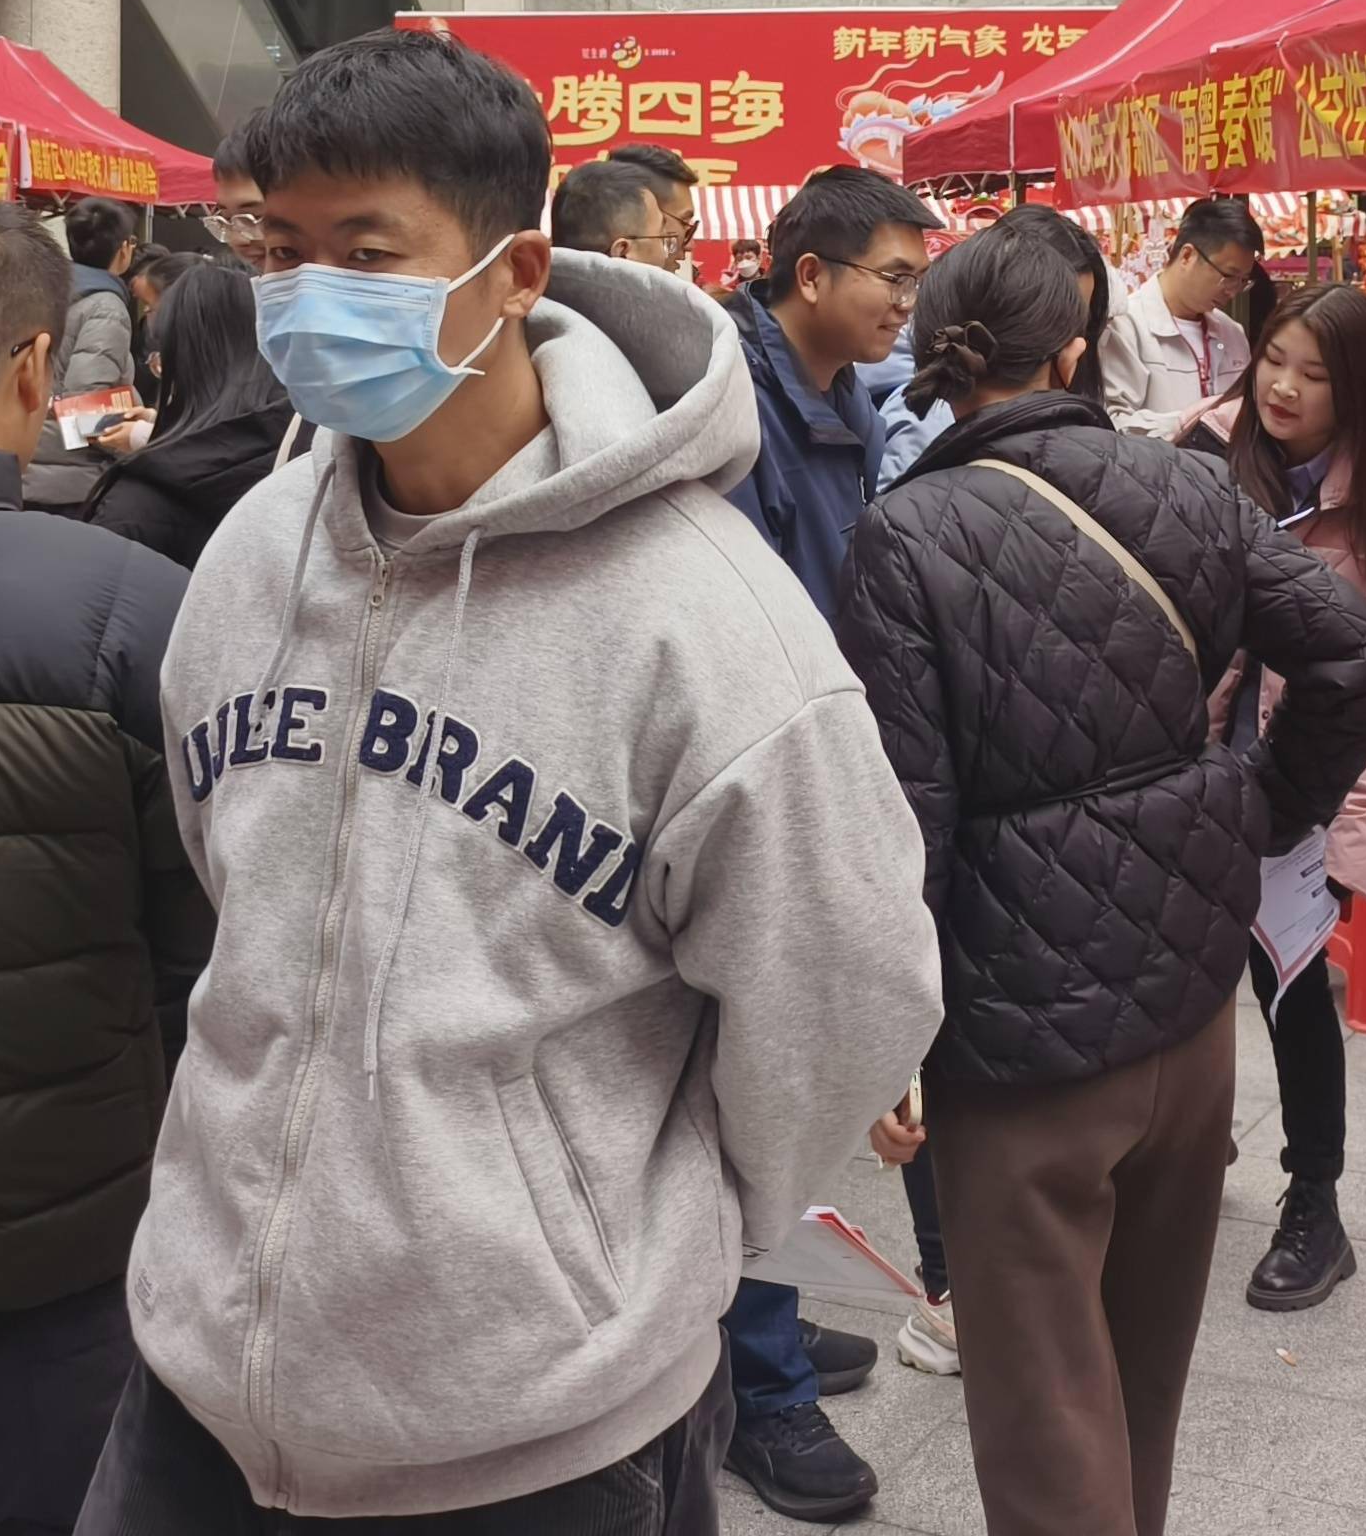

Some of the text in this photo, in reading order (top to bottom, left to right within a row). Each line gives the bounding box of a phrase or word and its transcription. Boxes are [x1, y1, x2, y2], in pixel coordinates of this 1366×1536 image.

[833, 24, 1008, 61] 新年新气象
[529, 70, 785, 147] 腾四海
